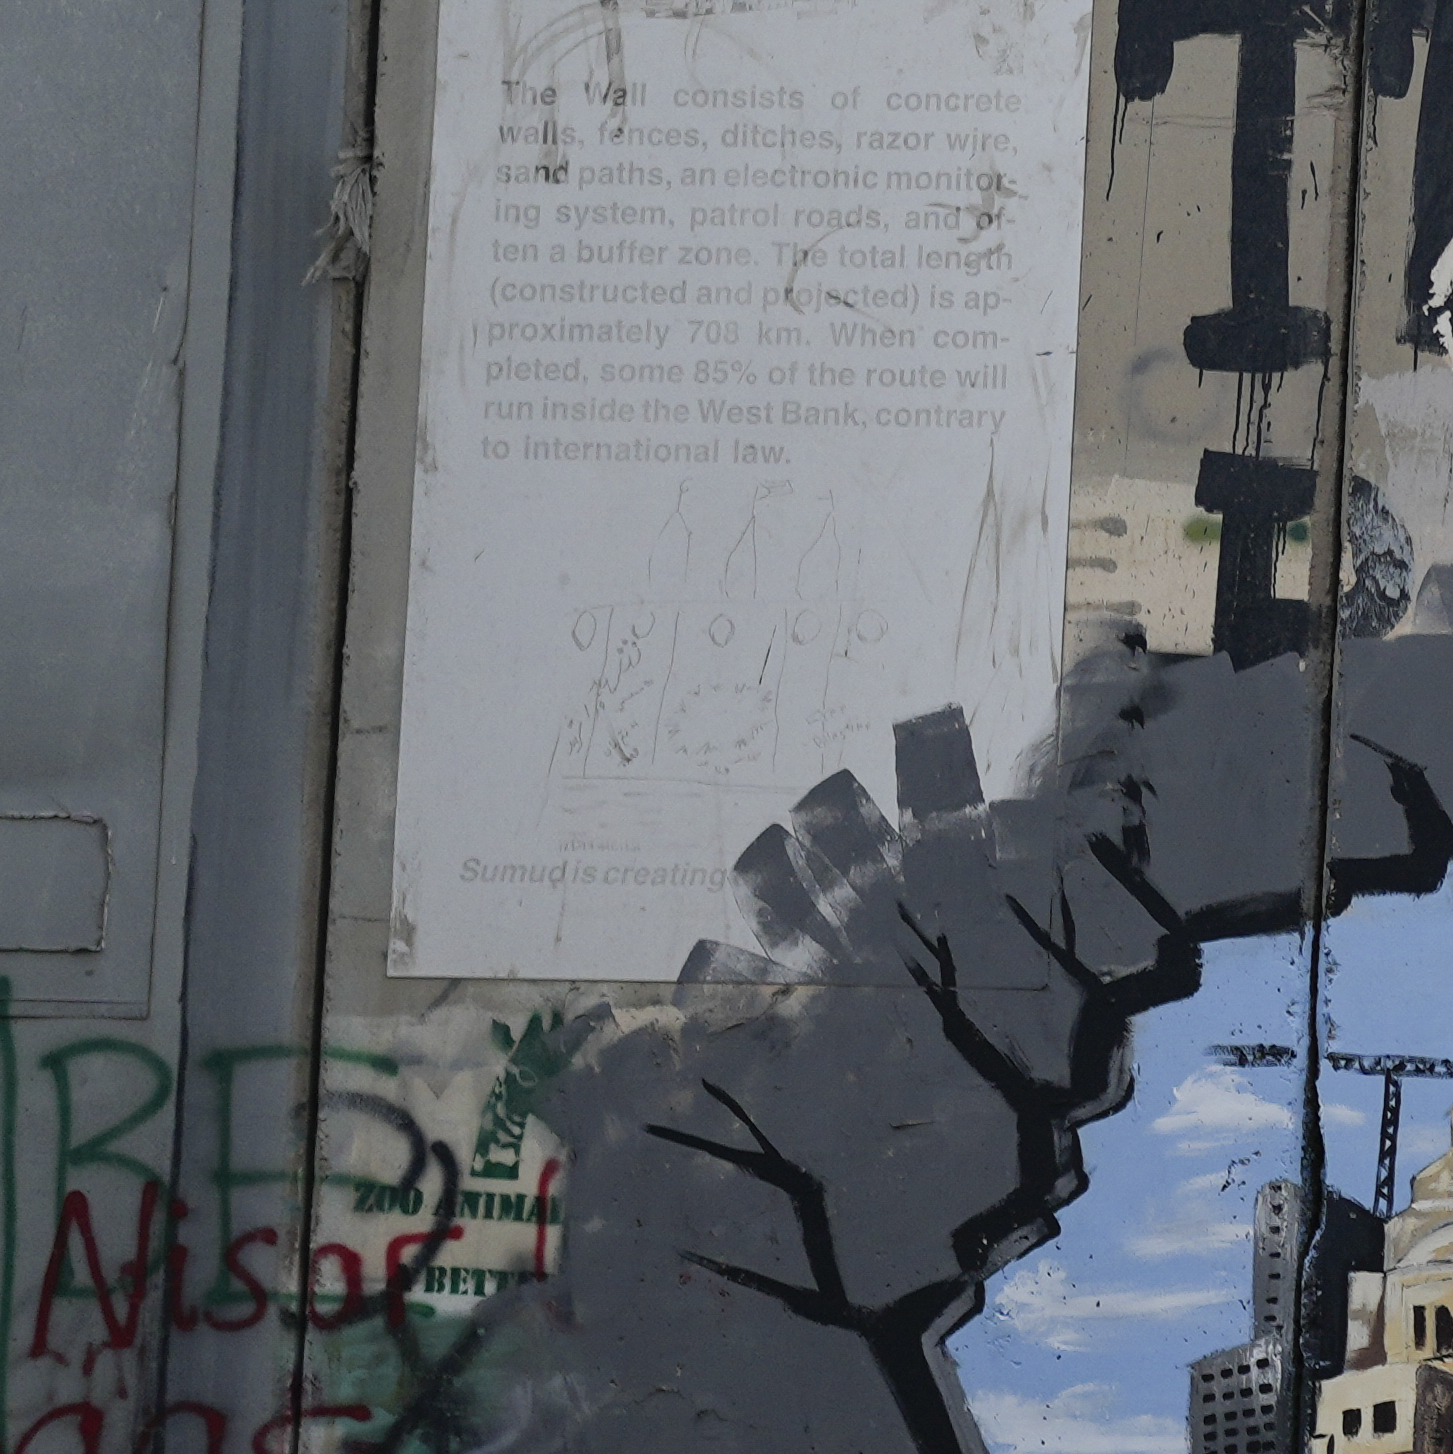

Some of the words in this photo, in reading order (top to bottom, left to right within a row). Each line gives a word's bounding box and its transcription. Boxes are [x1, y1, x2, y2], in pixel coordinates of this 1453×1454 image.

[501, 80, 558, 108] The
[584, 80, 647, 108] Wall
[672, 82, 805, 110] consists
[830, 84, 862, 113] of
[886, 86, 1023, 114] concrete
[499, 120, 585, 152] walls,
[599, 121, 709, 153] fences,
[720, 124, 843, 154] ditches,
[856, 129, 934, 152] razor
[946, 128, 1019, 157] wire,
[496, 159, 571, 186] sand
[579, 162, 673, 191] paths,
[680, 167, 717, 188] an
[722, 163, 878, 190] electronic
[886, 166, 1018, 193] monitor-
[493, 200, 541, 228] ing
[556, 201, 676, 229] system,
[690, 201, 780, 231] patrol
[794, 204, 890, 232] roads,
[904, 205, 961, 231] and
[976, 206, 1017, 232] of-
[491, 238, 539, 264] ten
[549, 243, 565, 264] a
[576, 238, 669, 266] buffer
[677, 242, 759, 267] zone.
[771, 240, 830, 268] The
[838, 241, 906, 269] total
[916, 242, 1013, 276] length
[489, 278, 688, 308] (constructed
[696, 281, 752, 307] and
[761, 282, 921, 316] projected)
[929, 284, 954, 310] is
[963, 287, 1013, 315] ap-
[486, 317, 670, 349] proximately
[688, 319, 740, 345] 708
[758, 320, 812, 347] km.
[830, 321, 916, 349] When
[933, 327, 1010, 351] com-
[486, 356, 589, 386] pleted,
[599, 362, 684, 384] some
[693, 359, 758, 387] 85%
[768, 359, 797, 387] of
[808, 361, 856, 388] the
[865, 363, 947, 389] route
[955, 363, 1008, 390] will
[483, 397, 534, 422] run
[541, 396, 635, 423] inside
[642, 398, 690, 425] the
[699, 398, 774, 426] West
[781, 399, 867, 429] Bank,
[875, 400, 1007, 436] contrary
[480, 435, 510, 461] to
[522, 436, 720, 465] international
[732, 437, 793, 466] law.
[459, 856, 569, 885] Sumud
[571, 859, 597, 885] is
[602, 861, 728, 894] creating
[353, 1183, 424, 1216] ZOO
